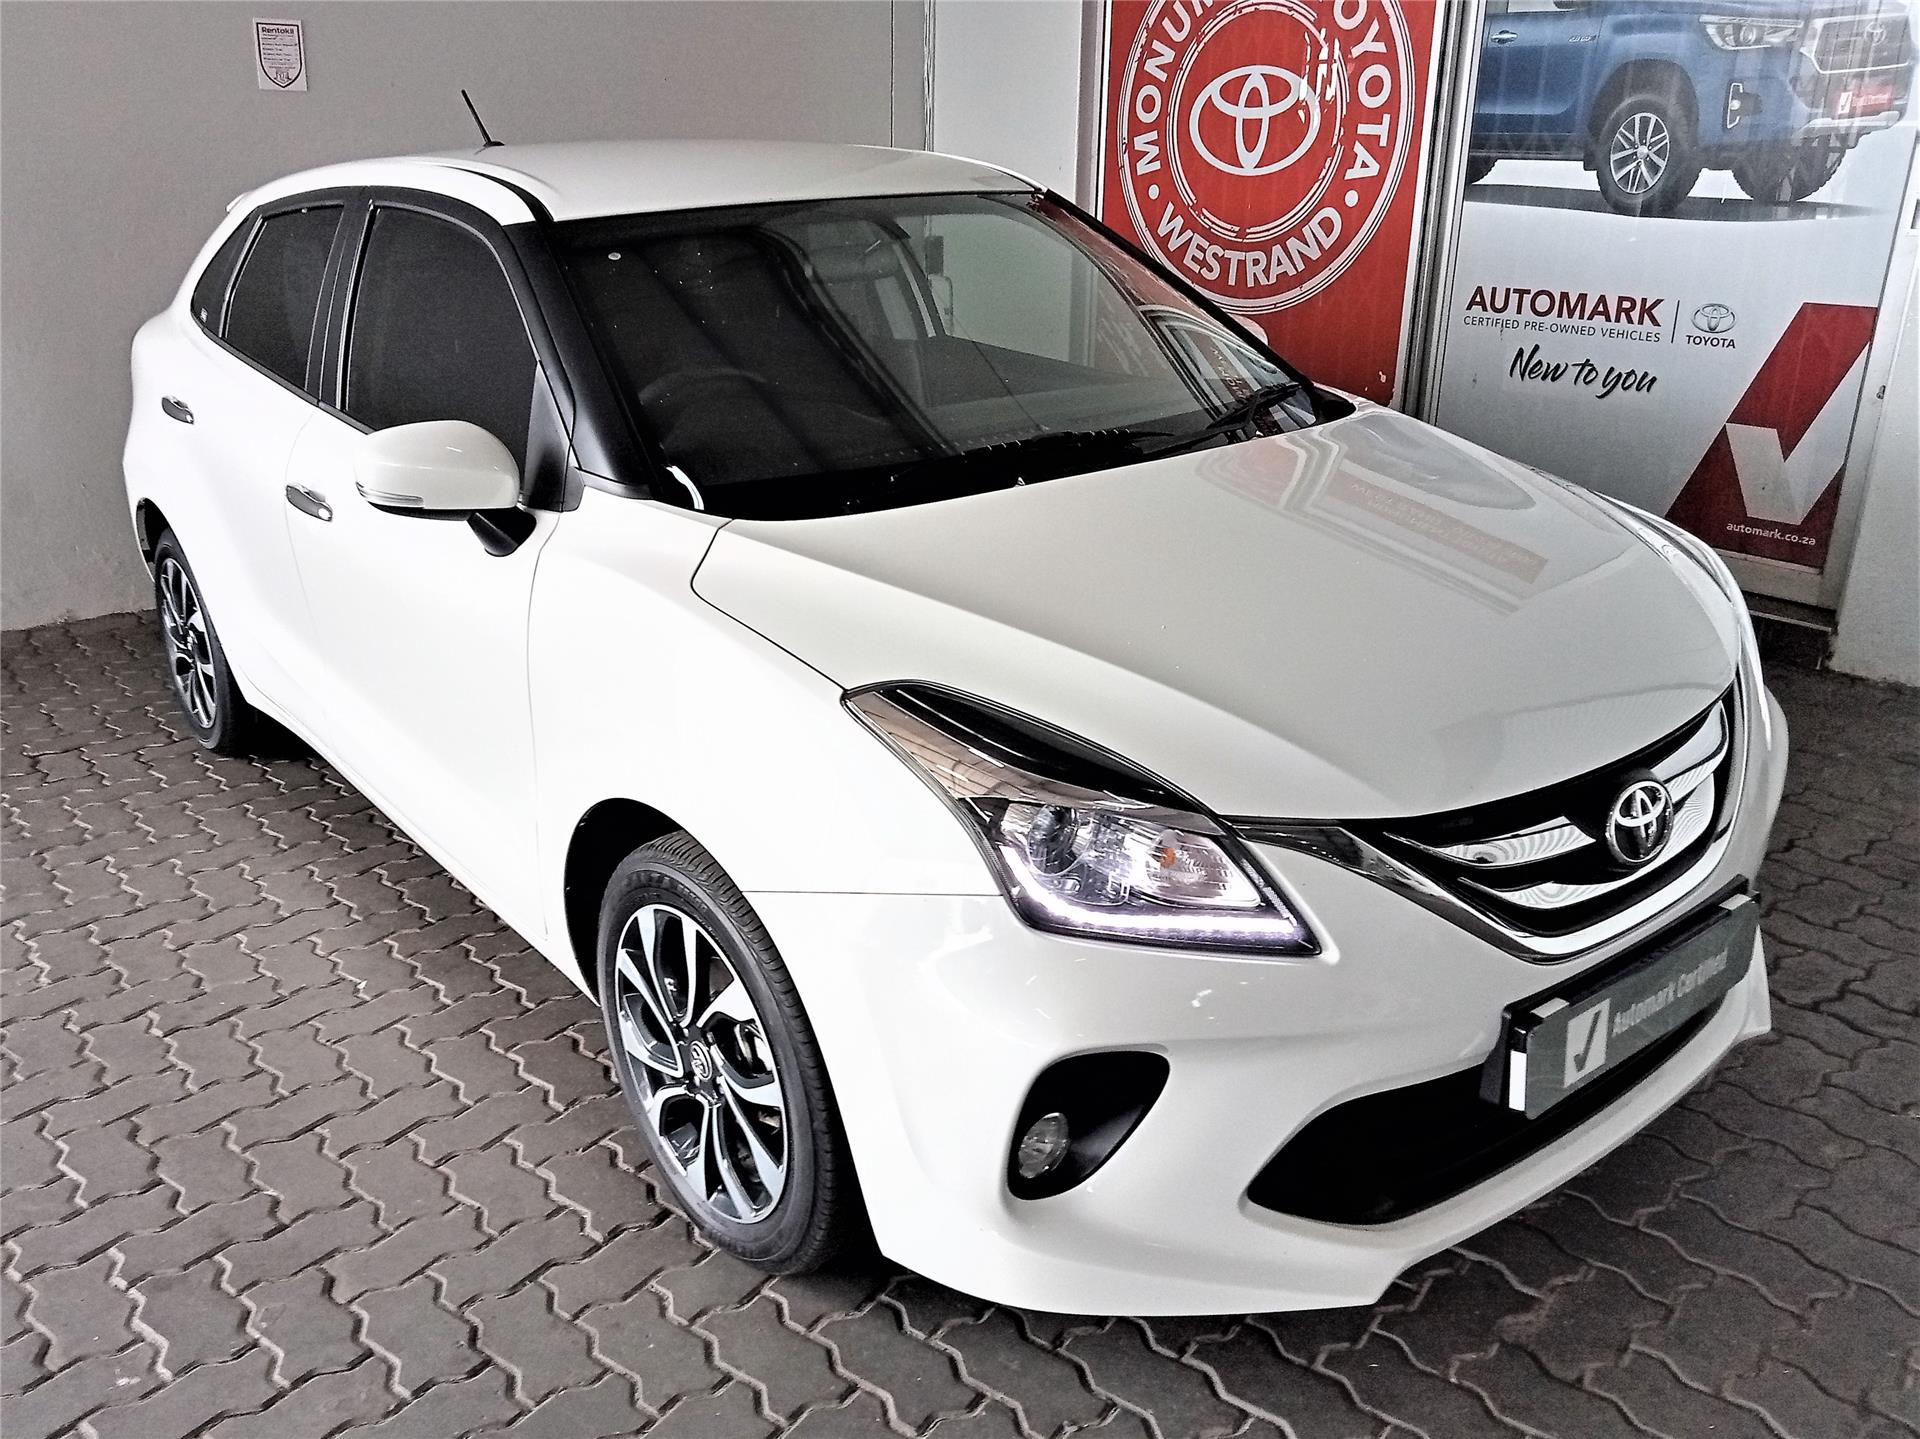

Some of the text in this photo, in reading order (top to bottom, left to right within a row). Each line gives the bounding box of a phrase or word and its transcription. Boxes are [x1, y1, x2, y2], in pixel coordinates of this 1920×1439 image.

[1320, 0, 1392, 180] OYOTA
[1156, 201, 1342, 288] WESTRAND
[1465, 285, 1665, 328] AUTOMARK
[1463, 315, 1661, 343] CERTIFIED PRE-OWNED VEHICLES
[1685, 334, 1736, 350] TOYOTA
[1509, 344, 1658, 400] New to you
[1726, 521, 1816, 546] automark.co.za
